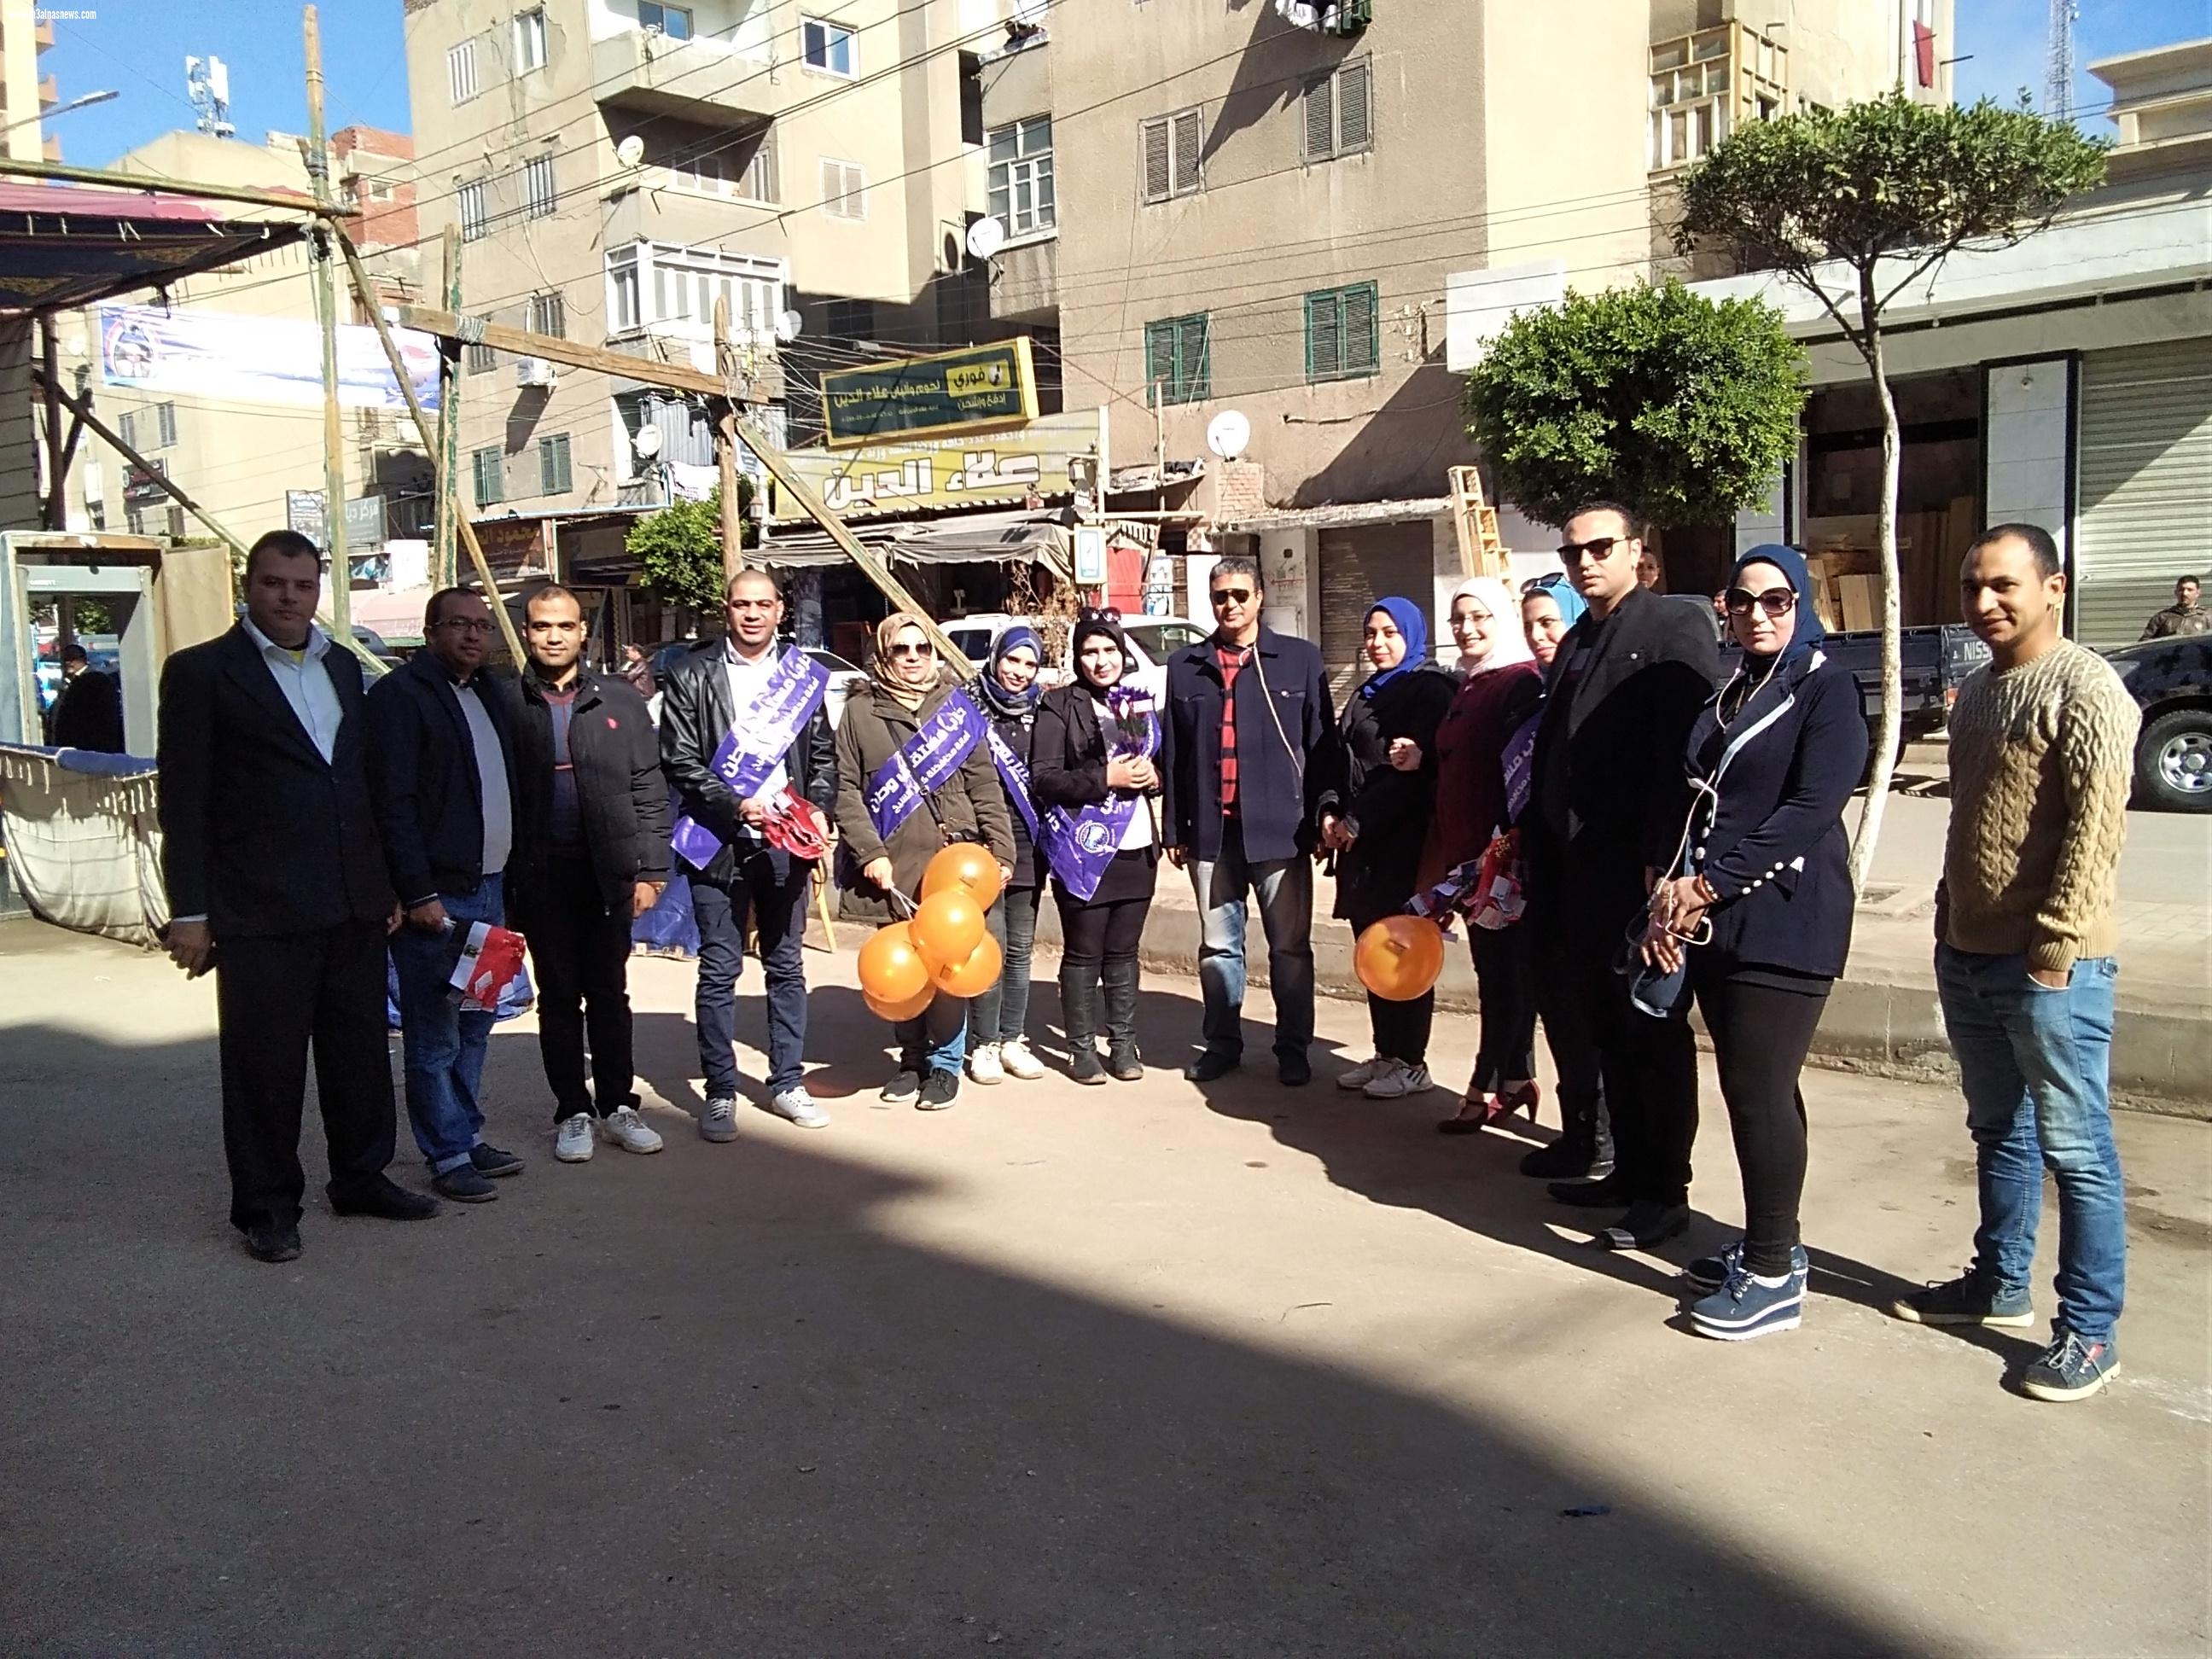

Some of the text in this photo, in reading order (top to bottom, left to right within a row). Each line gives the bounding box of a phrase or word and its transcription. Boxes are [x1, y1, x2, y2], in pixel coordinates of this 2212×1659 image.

[916, 379, 940, 395] لحوم
[954, 365, 985, 391] فوري
[834, 387, 863, 408] الدين
[866, 385, 888, 400] علاء
[824, 449, 1040, 510] علاء الدين
[1964, 640, 1993, 661] NISS
